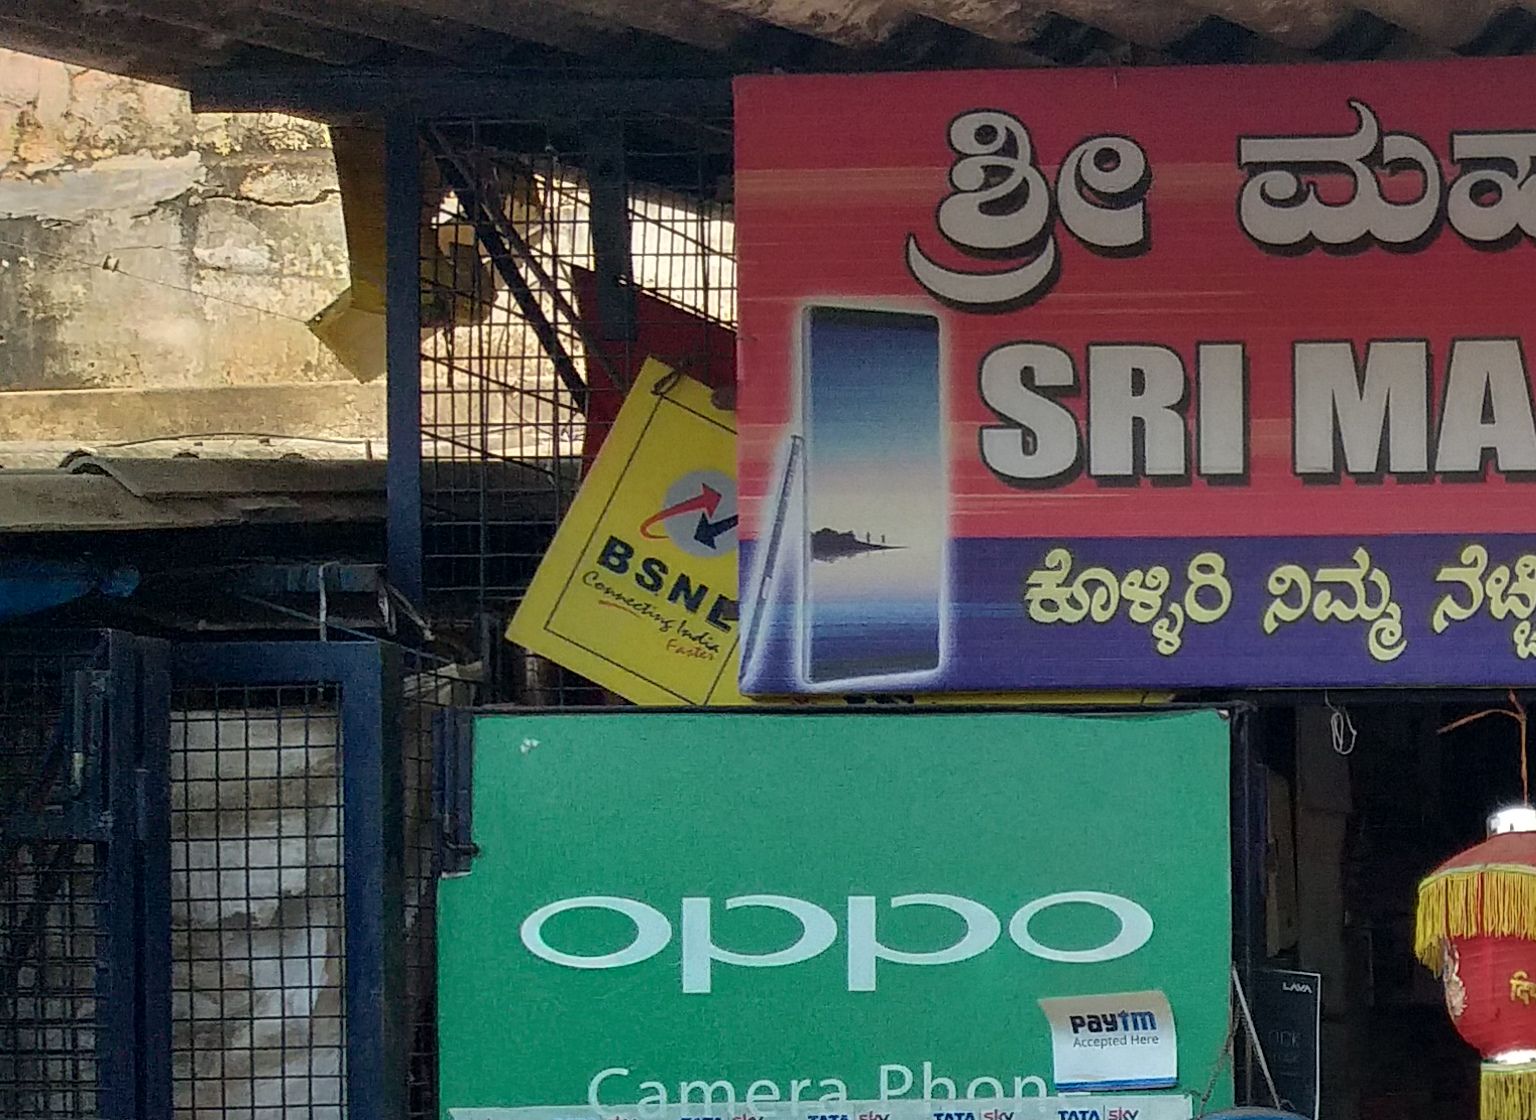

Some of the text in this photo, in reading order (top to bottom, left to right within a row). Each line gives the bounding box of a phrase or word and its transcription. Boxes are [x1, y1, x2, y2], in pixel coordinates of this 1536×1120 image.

[906, 108, 1152, 311] ಶ್ರೀ
[978, 340, 1252, 487] SRI
[597, 535, 739, 633] BSNL
[1262, 547, 1407, 662] ನಿಮ್ಮ
[1281, 981, 1313, 994] LAVA
[587, 1061, 1048, 1119] Camera Phon
[1073, 1033, 1159, 1049] Accepted Here
